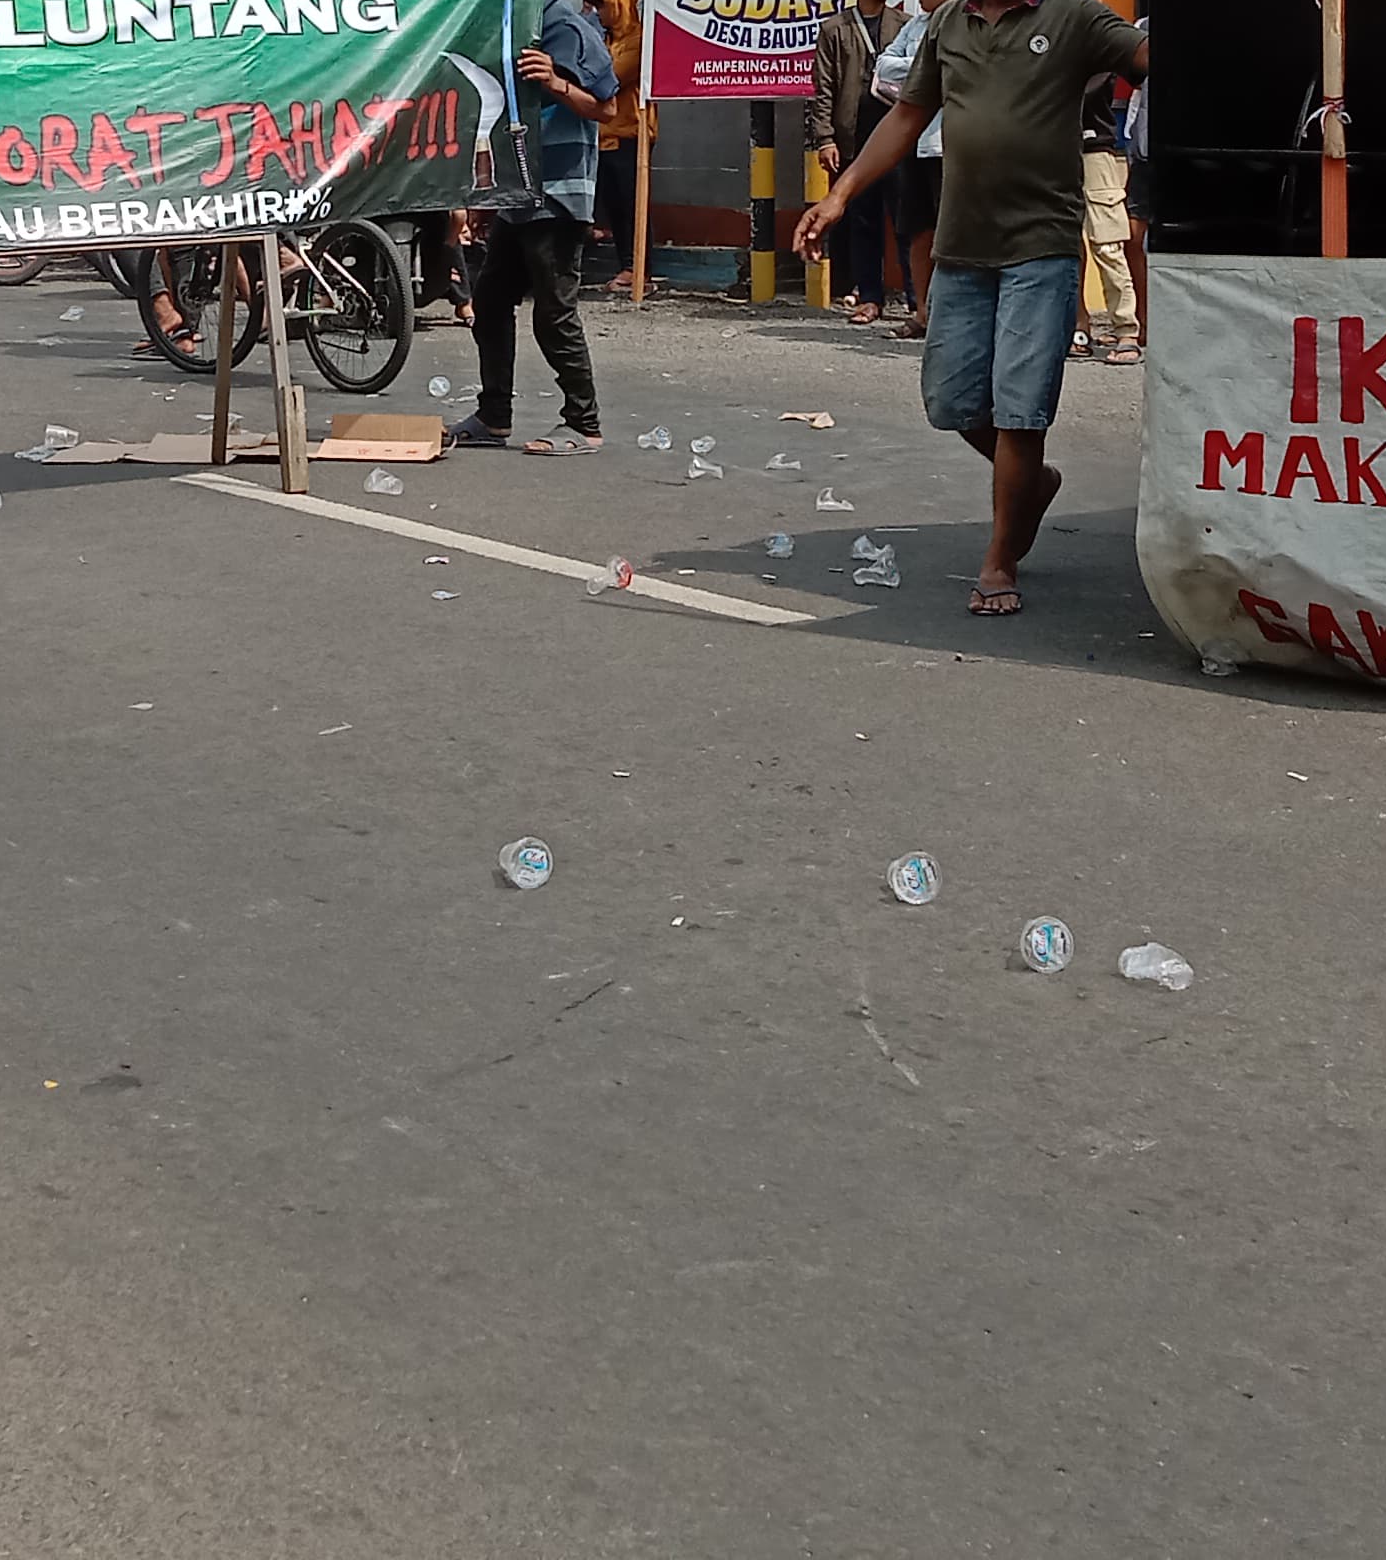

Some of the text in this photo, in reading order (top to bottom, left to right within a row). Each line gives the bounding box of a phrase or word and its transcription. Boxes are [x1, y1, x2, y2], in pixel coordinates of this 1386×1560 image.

[704, 20, 819, 49] DESA BAUJE
[694, 59, 791, 73] MEMPERINGATI
[751, 76, 776, 85] BARU
